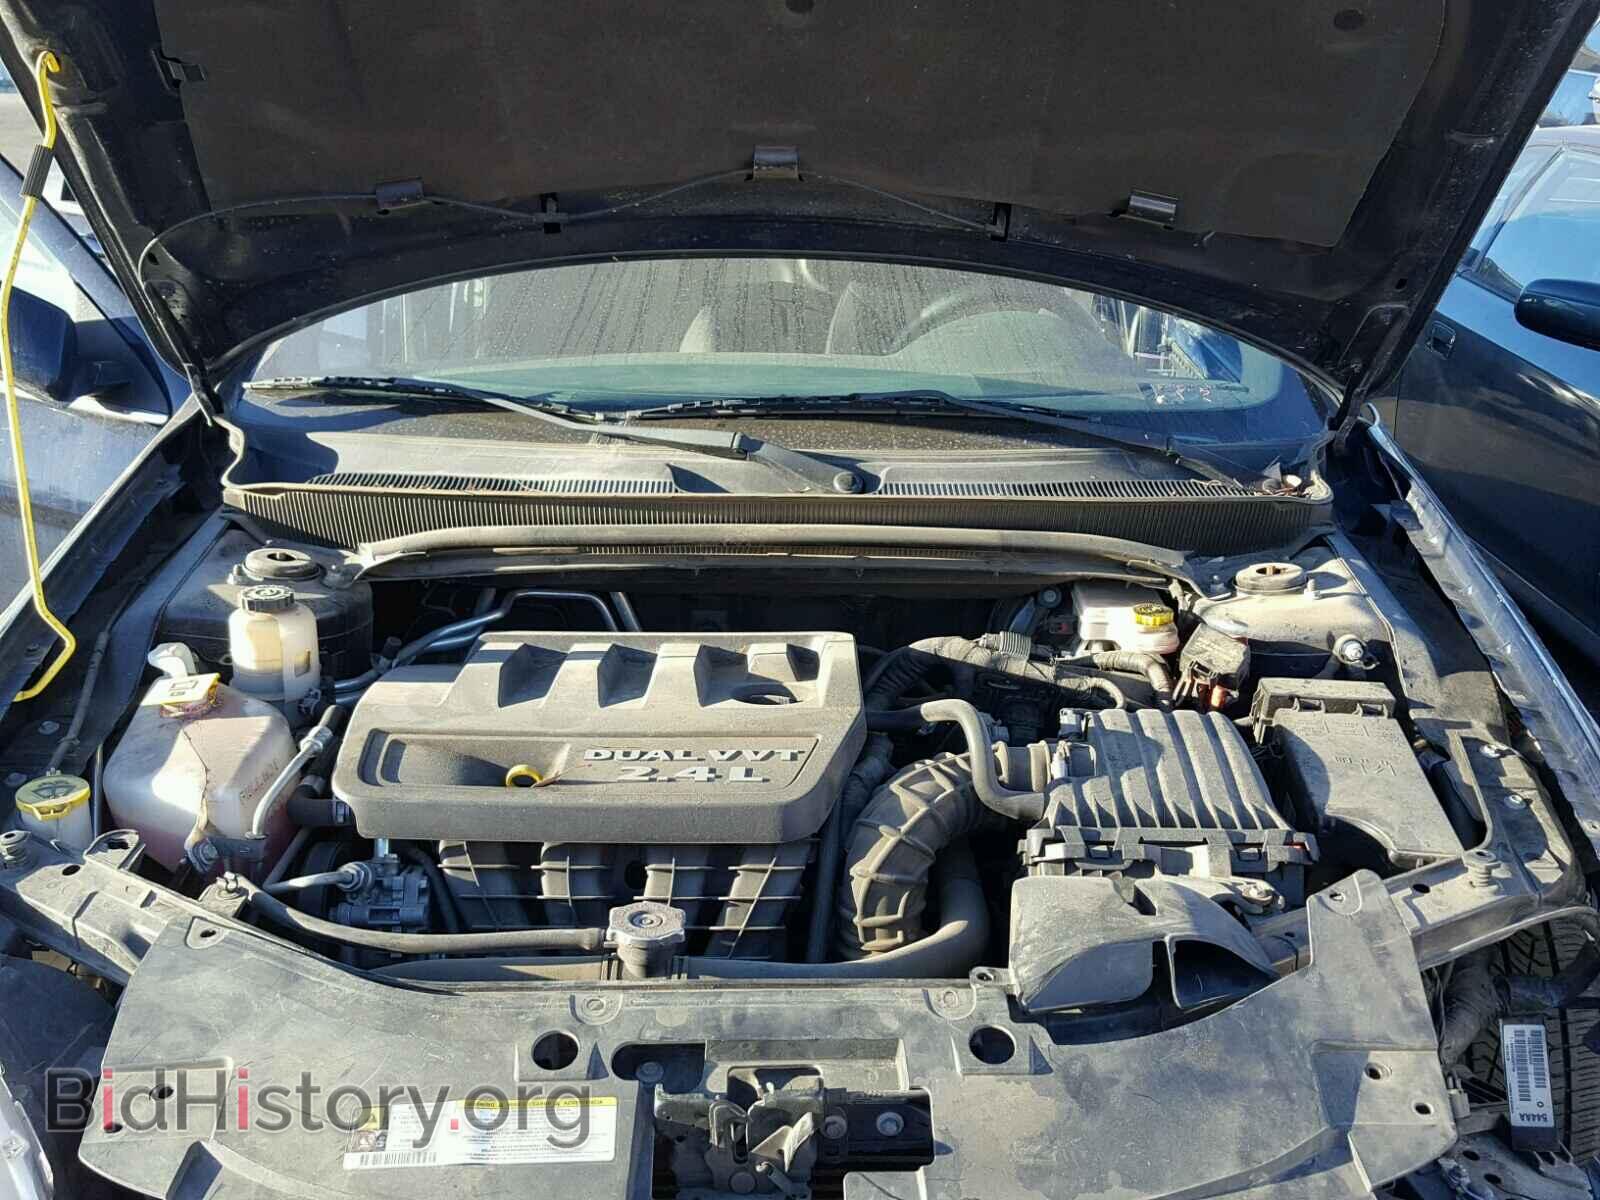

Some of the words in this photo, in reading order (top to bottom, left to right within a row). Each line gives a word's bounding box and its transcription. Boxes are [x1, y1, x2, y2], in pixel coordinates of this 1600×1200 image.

[583, 749, 705, 762] DUAL
[708, 749, 806, 762] VVT
[616, 765, 770, 783] 2.4L
